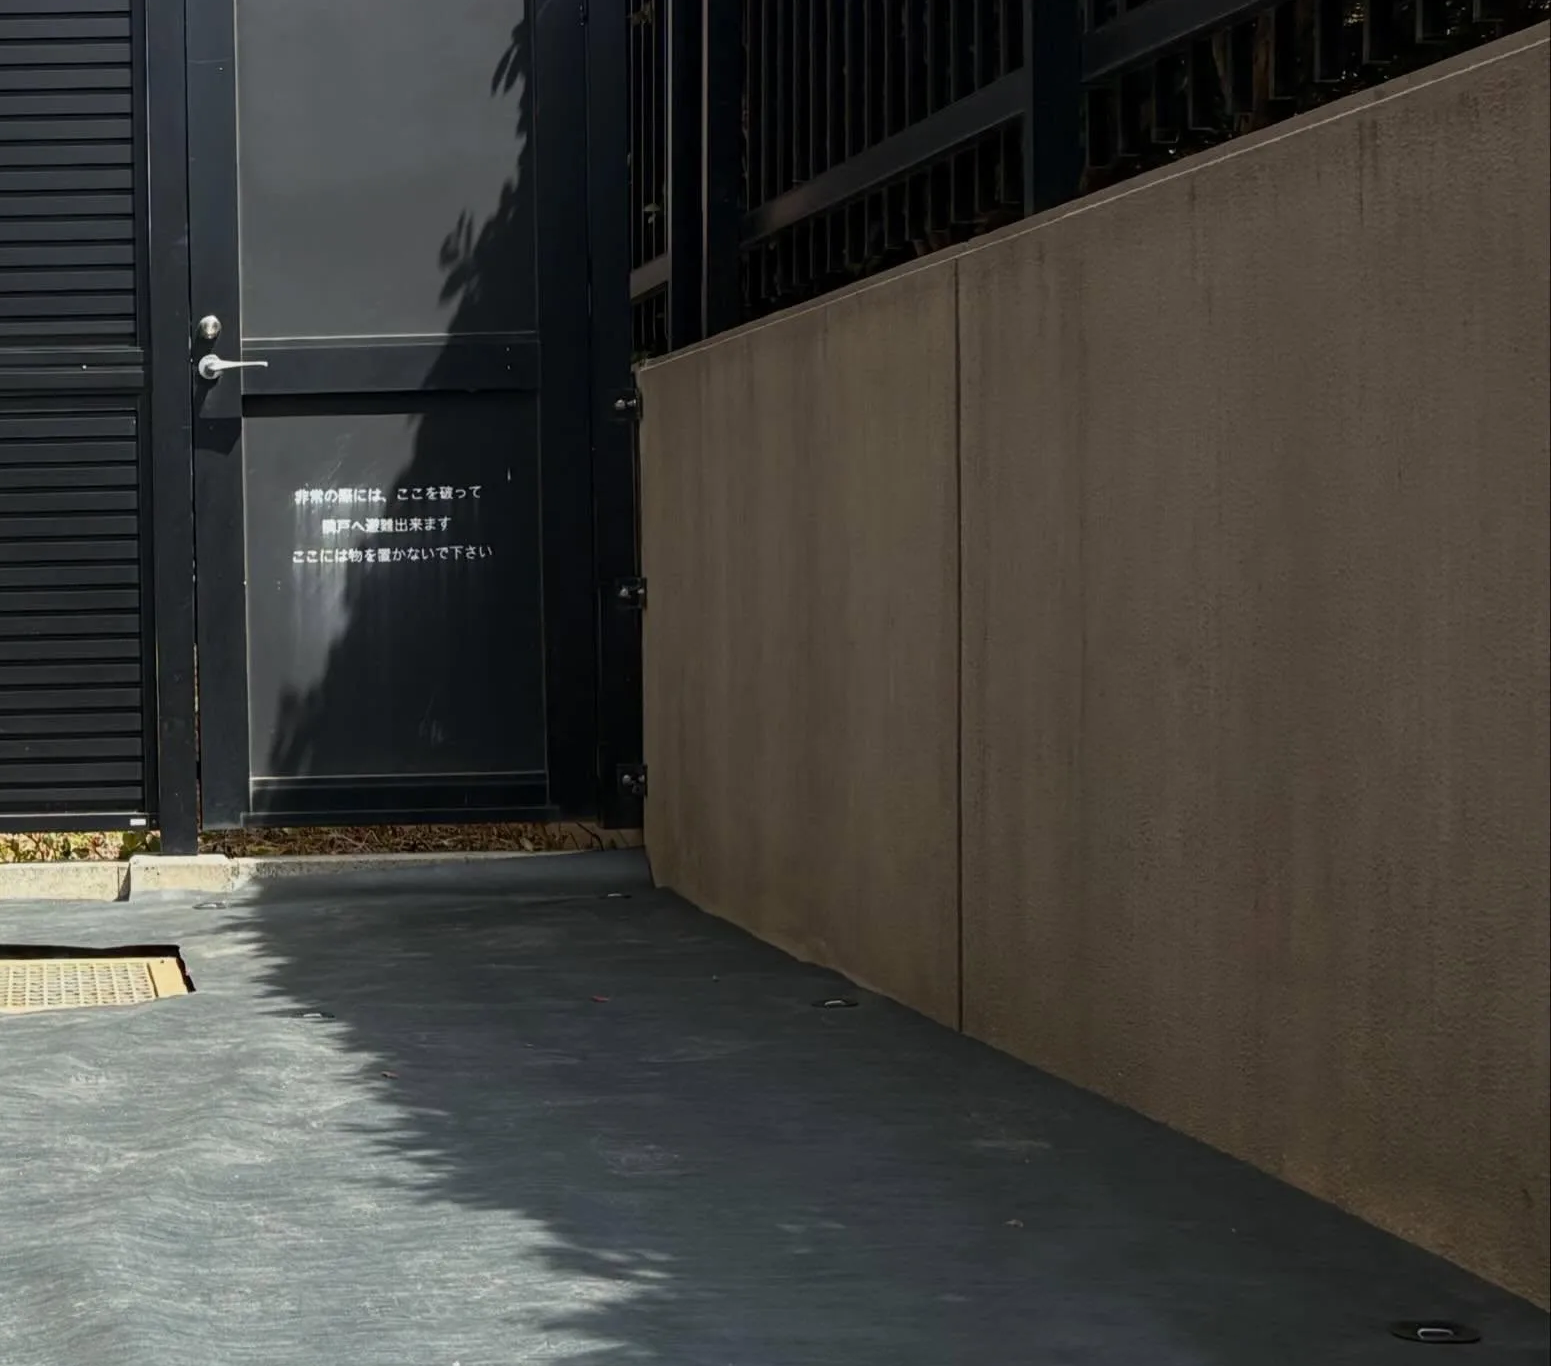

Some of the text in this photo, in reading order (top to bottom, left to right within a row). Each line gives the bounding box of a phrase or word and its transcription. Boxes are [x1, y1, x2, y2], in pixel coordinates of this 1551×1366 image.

[292, 544, 493, 564] ここには物を置かないで下さい
